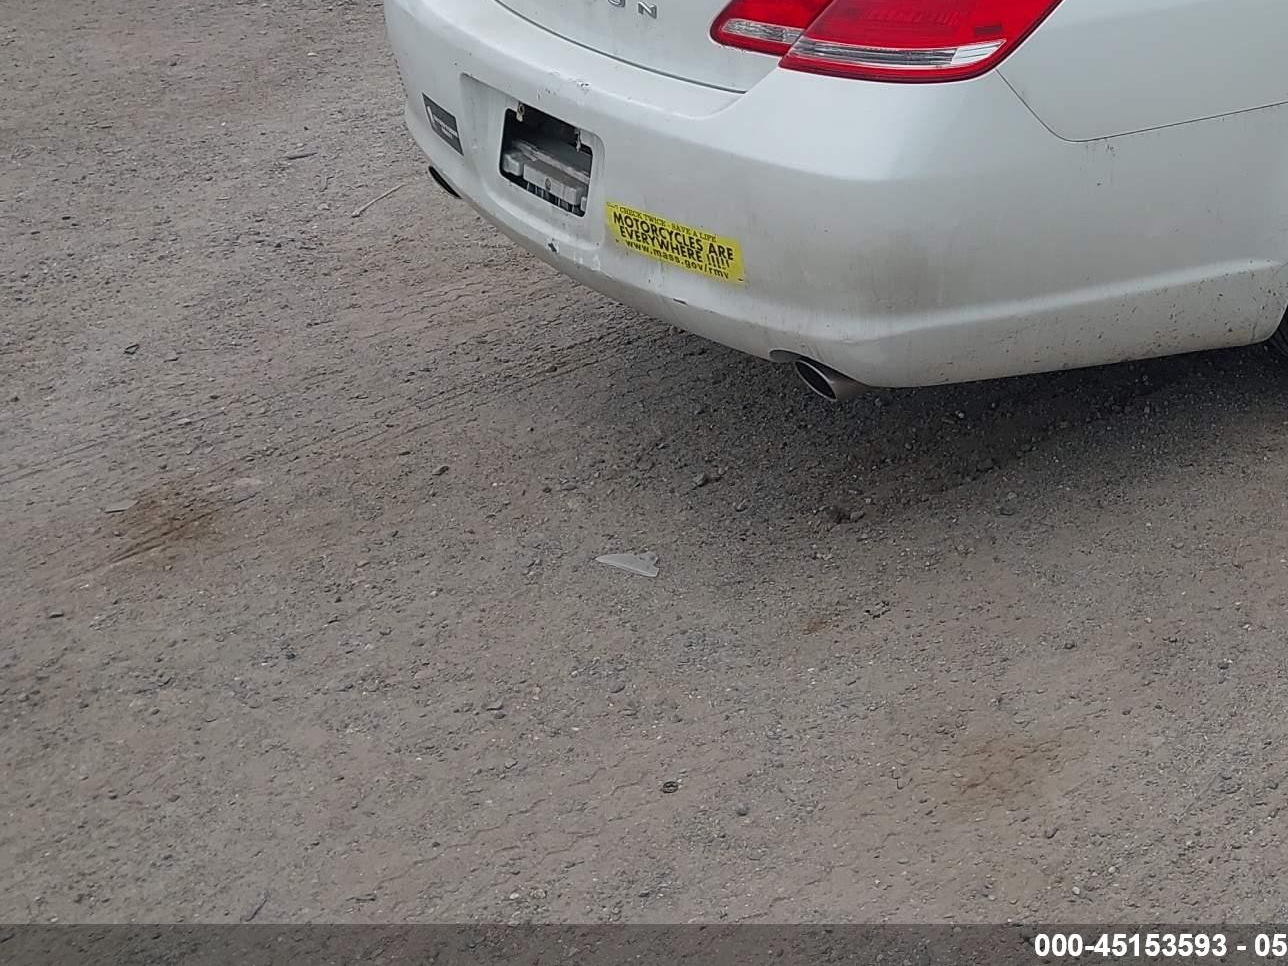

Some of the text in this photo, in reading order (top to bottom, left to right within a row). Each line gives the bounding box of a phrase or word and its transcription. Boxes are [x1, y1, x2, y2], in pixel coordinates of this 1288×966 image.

[613, 211, 734, 261] MOTORCYCLES ARE
[620, 225, 704, 263] EVERYWHERE
[643, 213, 666, 227] TWICE
[671, 223, 692, 236] SAVE
[699, 232, 717, 243] LIFE
[625, 239, 729, 280] www.mass.gov/rmv
